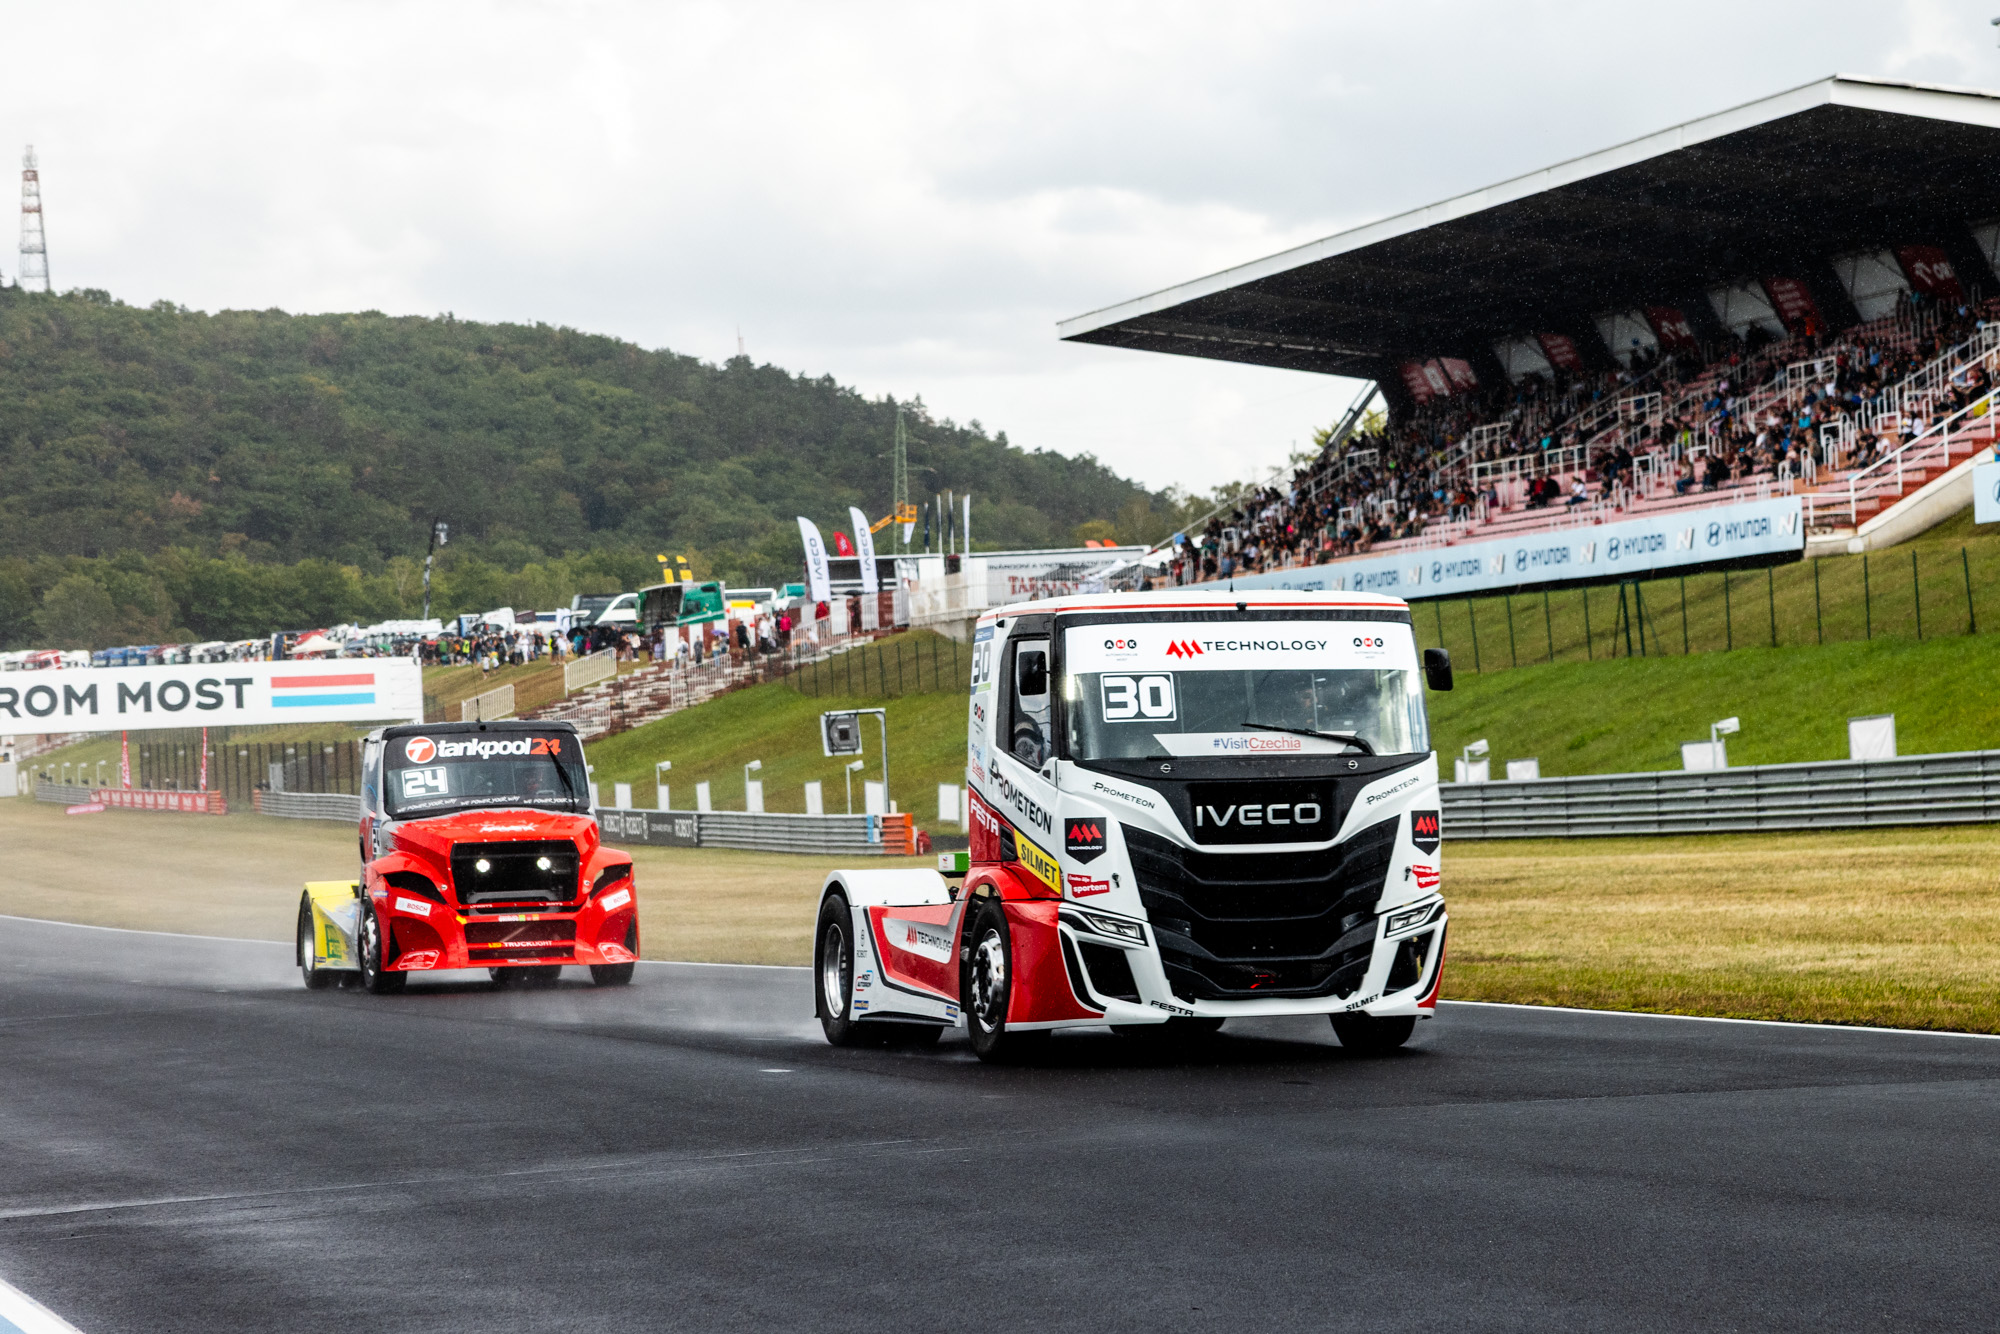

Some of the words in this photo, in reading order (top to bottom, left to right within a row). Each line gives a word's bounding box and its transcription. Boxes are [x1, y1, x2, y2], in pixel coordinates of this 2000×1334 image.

[1725, 517, 1772, 540] HYUNDAI
[860, 527, 872, 571] IVECO
[1531, 546, 1571, 567] HYUNDAI
[1623, 533, 1667, 555] HYUNDAI
[809, 537, 823, 580] IVECO
[1445, 558, 1482, 578] HYUNDAI
[1203, 639, 1328, 652] TECHNOLOGY
[973, 641, 991, 685] 30
[0, 683, 98, 718] ROM
[117, 677, 254, 714] MOST
[1103, 675, 1174, 720] 30
[1212, 735, 1302, 752] #VisitCzechia
[404, 769, 445, 796] 24
[1365, 776, 1420, 806] PROMETEON
[987, 758, 1052, 835] PROMETEON
[1093, 781, 1156, 810] PROMETEON
[970, 797, 999, 837] FESTA
[1196, 802, 1321, 827] IVECO
[1021, 843, 1057, 884] SILMET
[1073, 883, 1108, 894] sportem
[406, 902, 429, 913] BOSCH
[503, 940, 553, 948] TRUCKLIGHT
[1150, 1000, 1194, 1018] FESTA
[1345, 993, 1380, 1013] SILMET
